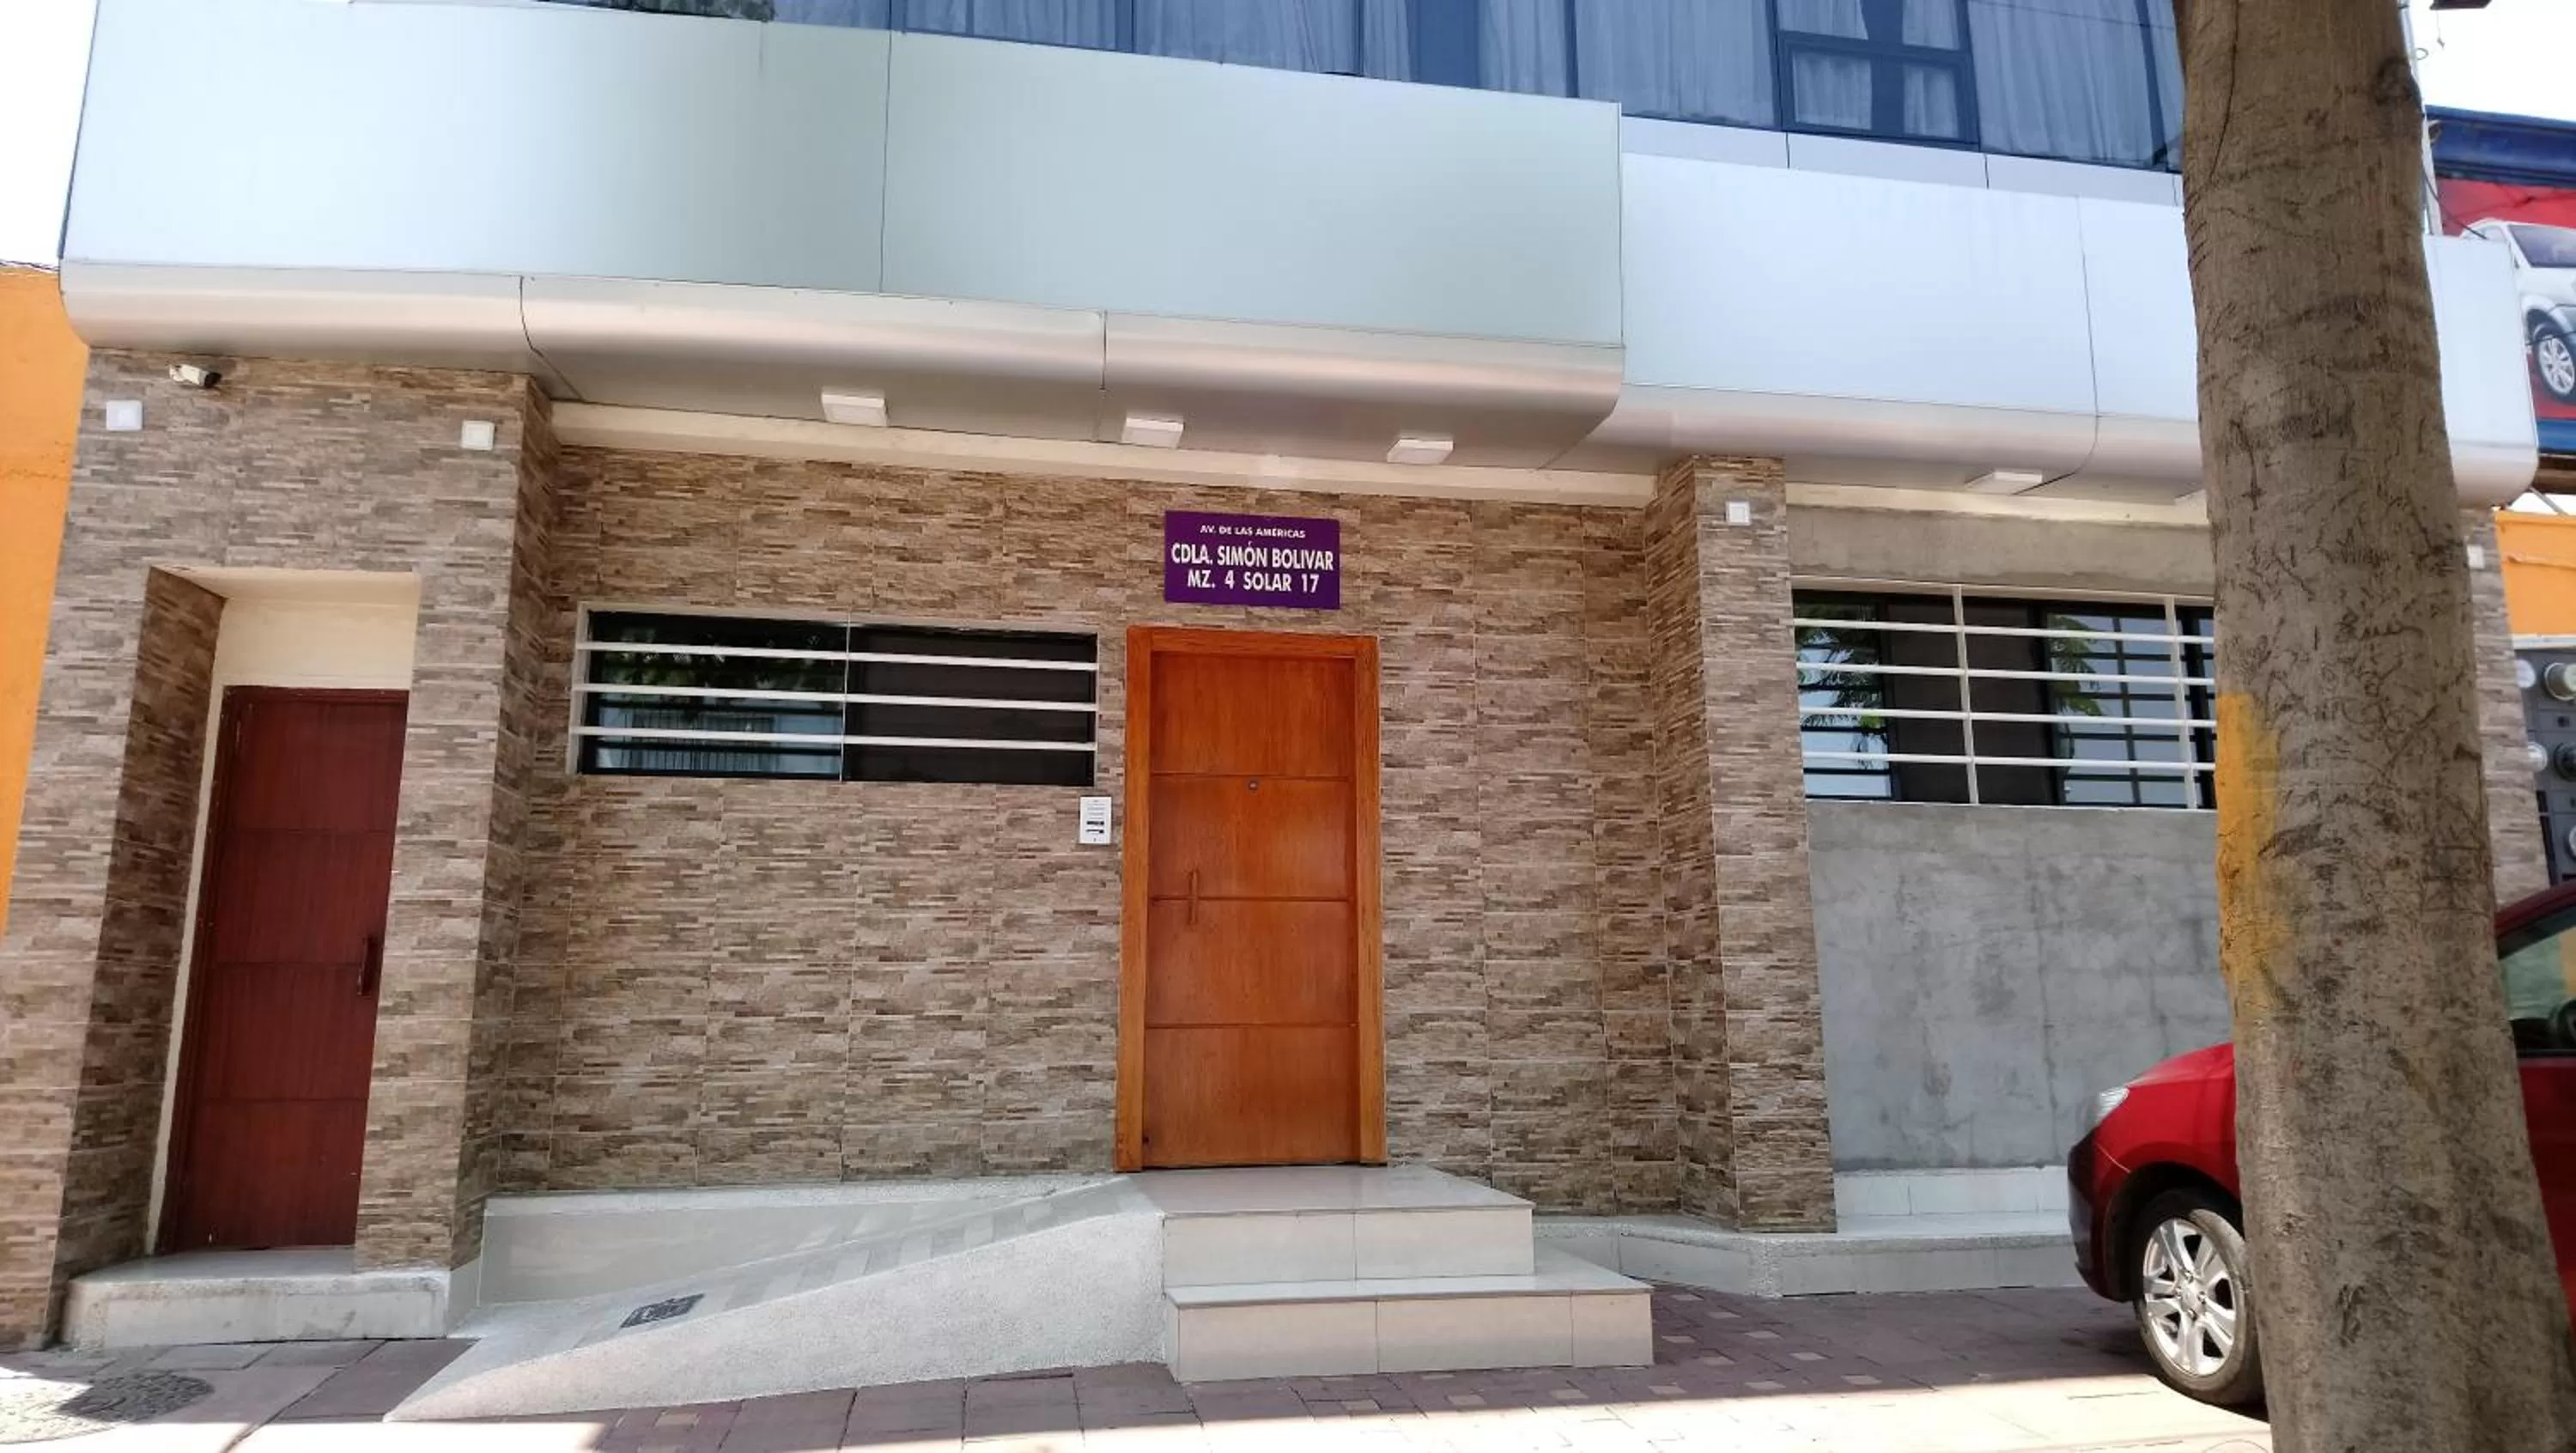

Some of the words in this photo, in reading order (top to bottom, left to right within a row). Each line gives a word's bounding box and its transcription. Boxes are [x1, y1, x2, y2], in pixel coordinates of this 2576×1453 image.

[1200, 525, 1217, 534] AV.
[1236, 526, 1253, 536] LAS
[1171, 543, 1212, 564] CDLA.
[1218, 541, 1267, 568] SIMÓN
[1273, 549, 1334, 570] BOLIVAR
[1188, 569, 1215, 588] MZ.
[1224, 570, 1234, 589] 4
[1243, 572, 1291, 592] SOLAR
[1302, 574, 1319, 593] 17
